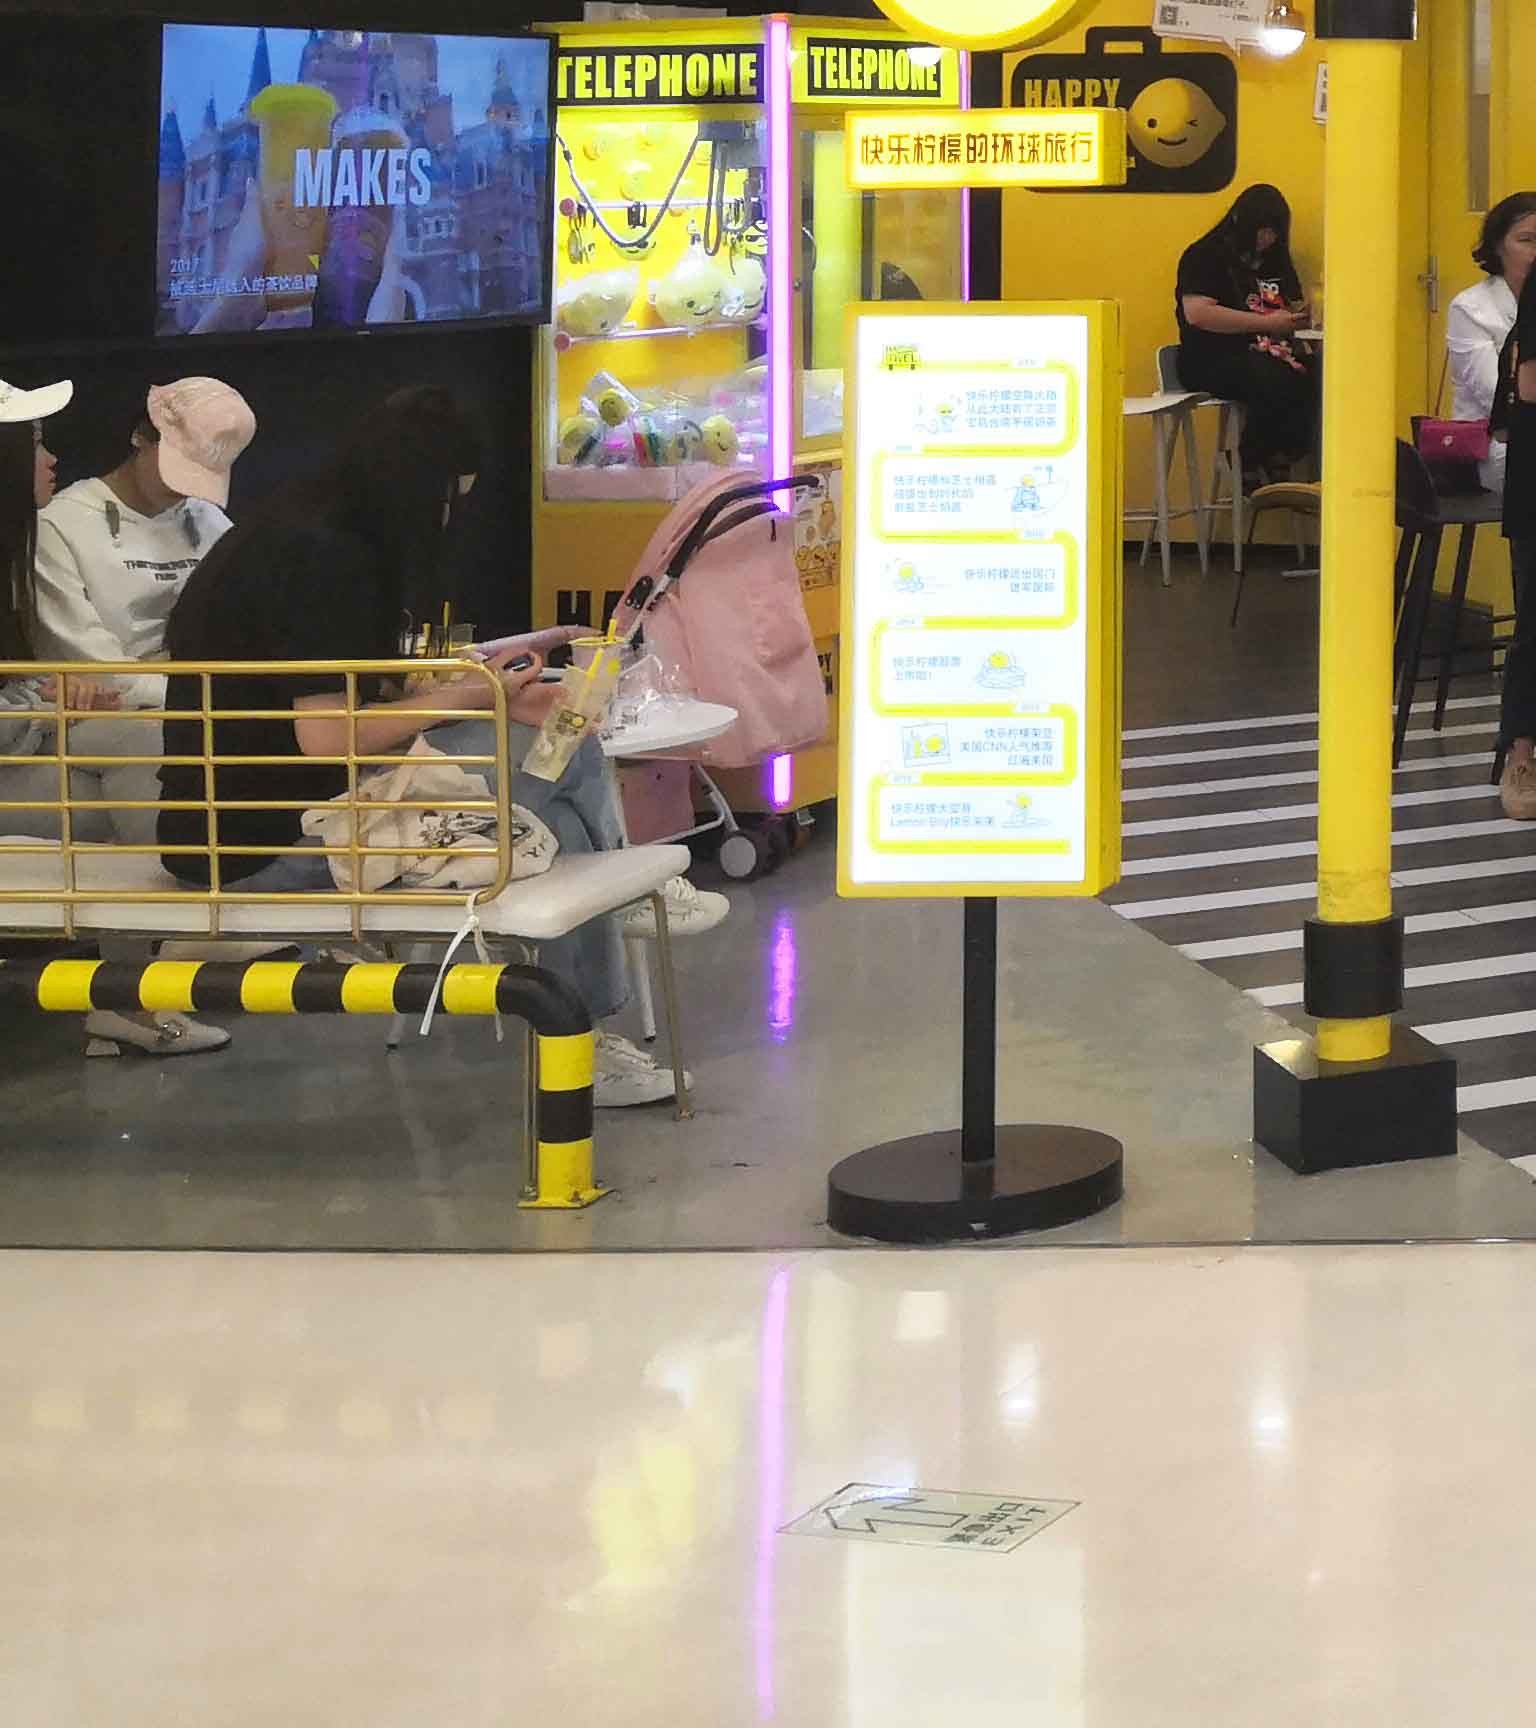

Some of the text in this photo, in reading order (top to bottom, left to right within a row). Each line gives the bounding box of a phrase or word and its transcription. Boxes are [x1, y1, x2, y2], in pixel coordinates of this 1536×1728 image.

[556, 52, 758, 99] TELEPHONE
[809, 45, 940, 92] TELEPHONE
[1023, 77, 1121, 108] HAPPY
[860, 130, 1094, 167] 快乐柠檬的环球旅行
[293, 146, 434, 207] MAKES
